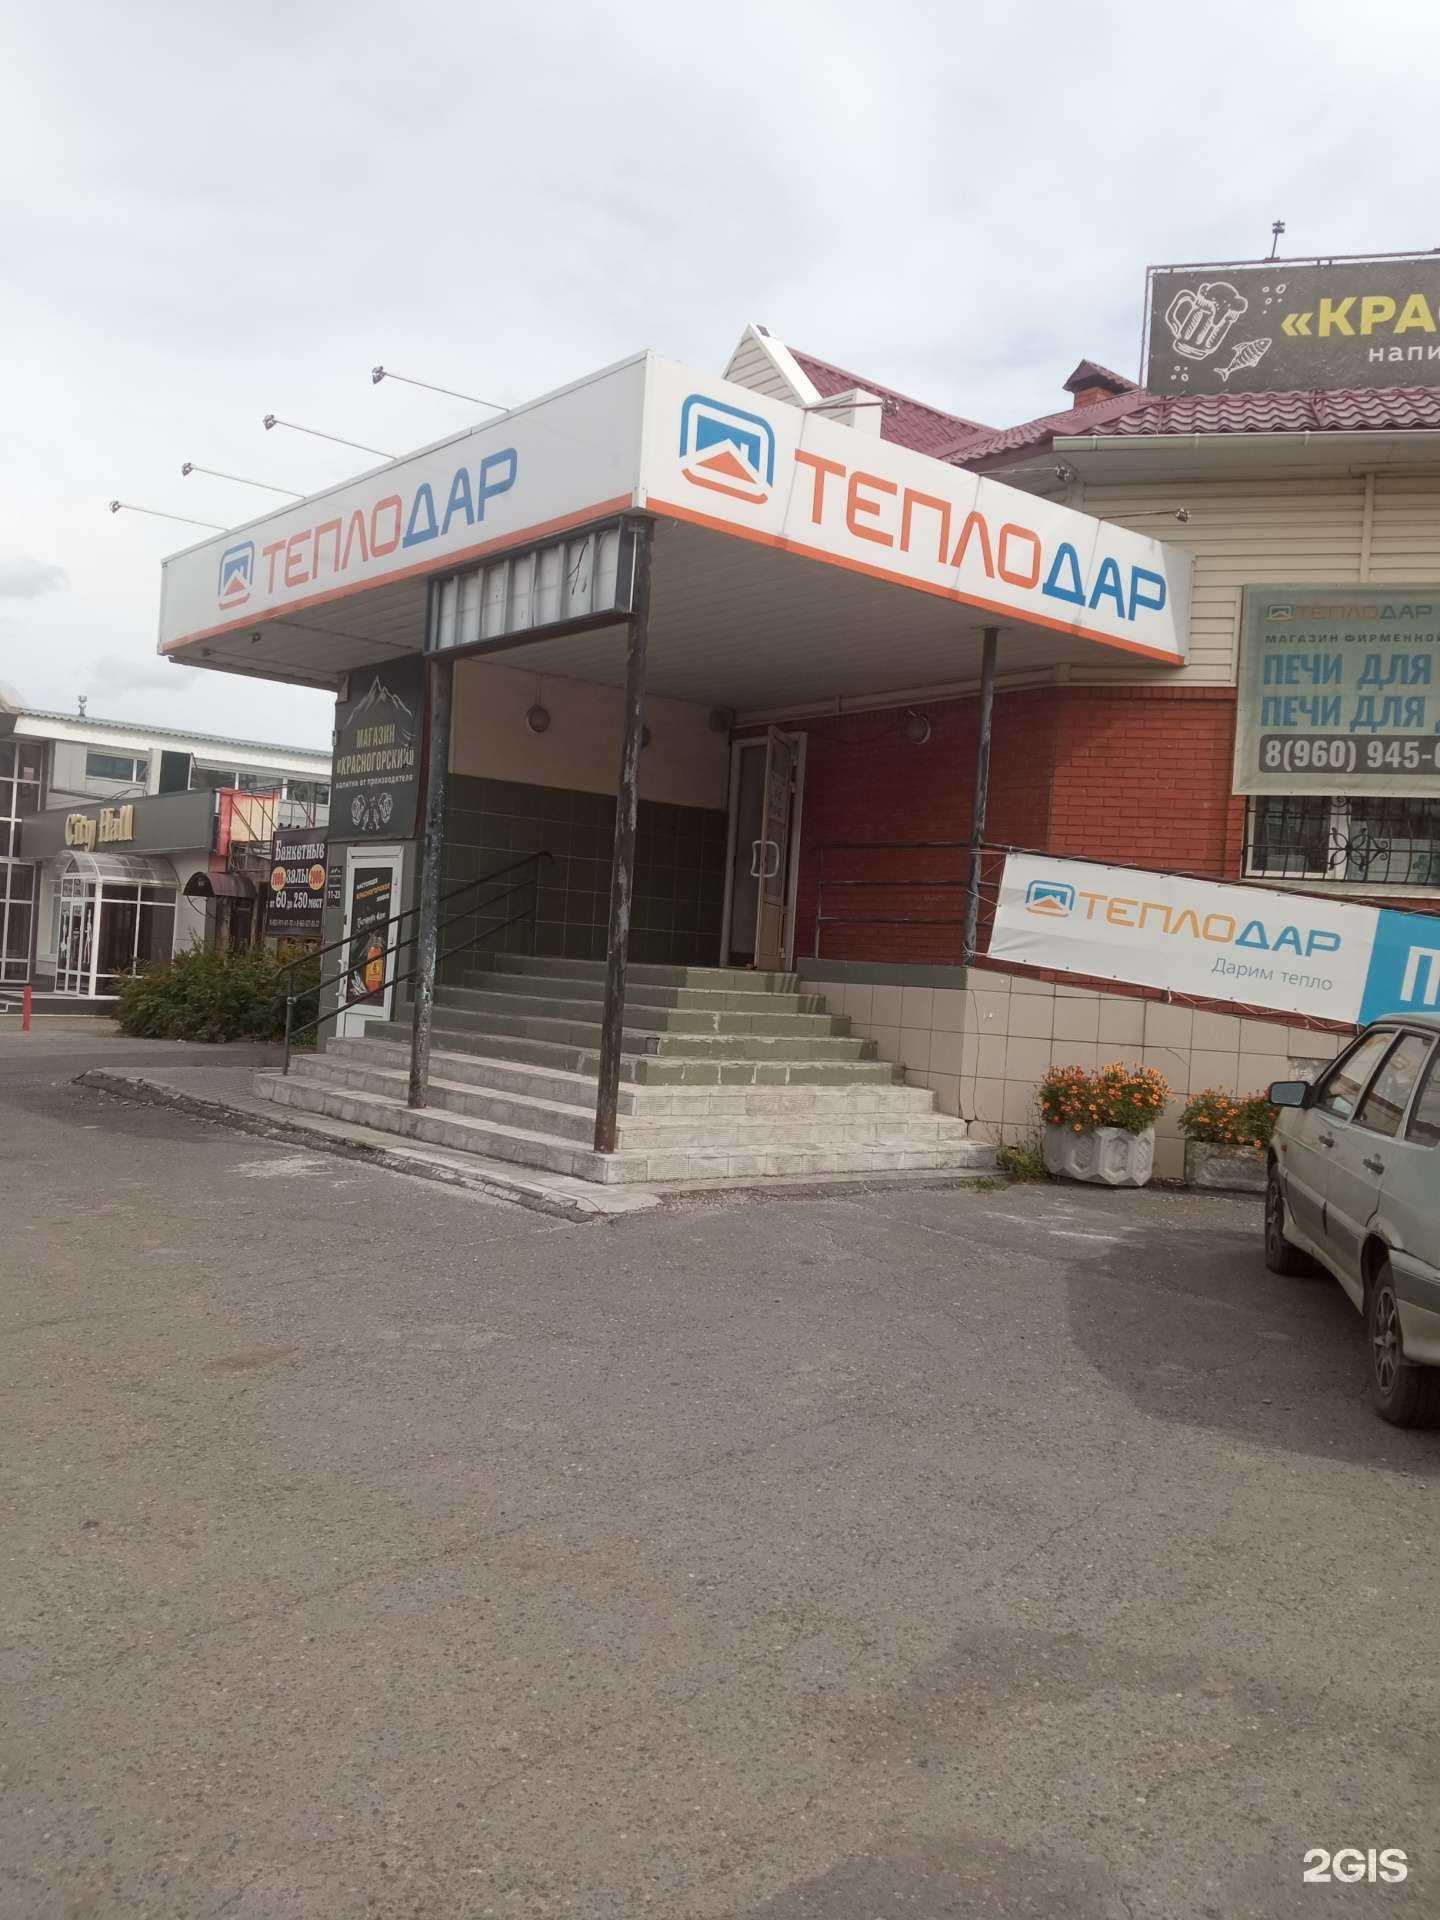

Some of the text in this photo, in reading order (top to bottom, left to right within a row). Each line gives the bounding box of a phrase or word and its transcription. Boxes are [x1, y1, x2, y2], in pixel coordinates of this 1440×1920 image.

[1281, 293, 1440, 337] «КРА
[262, 447, 518, 595] ТЕПЛОДАР
[795, 448, 1166, 621] ТЕПЛОДАР
[1295, 604, 1433, 620] ТЕПЛОДАР
[1265, 632, 1440, 644] МАГАЗИН ФИРМЕННО
[1263, 654, 1432, 690] ПЕЧИ ДЛЯ
[1261, 696, 1342, 727] ПЕЧИ
[1350, 696, 1425, 733] ДЛЯ
[356, 723, 396, 749] МАГАЗИН
[1265, 740, 1357, 772] 8(960)
[293, 892, 308, 908] 250
[1078, 891, 1342, 957] ТЕПЛОДАР
[1211, 957, 1333, 991] Дарим тепло
